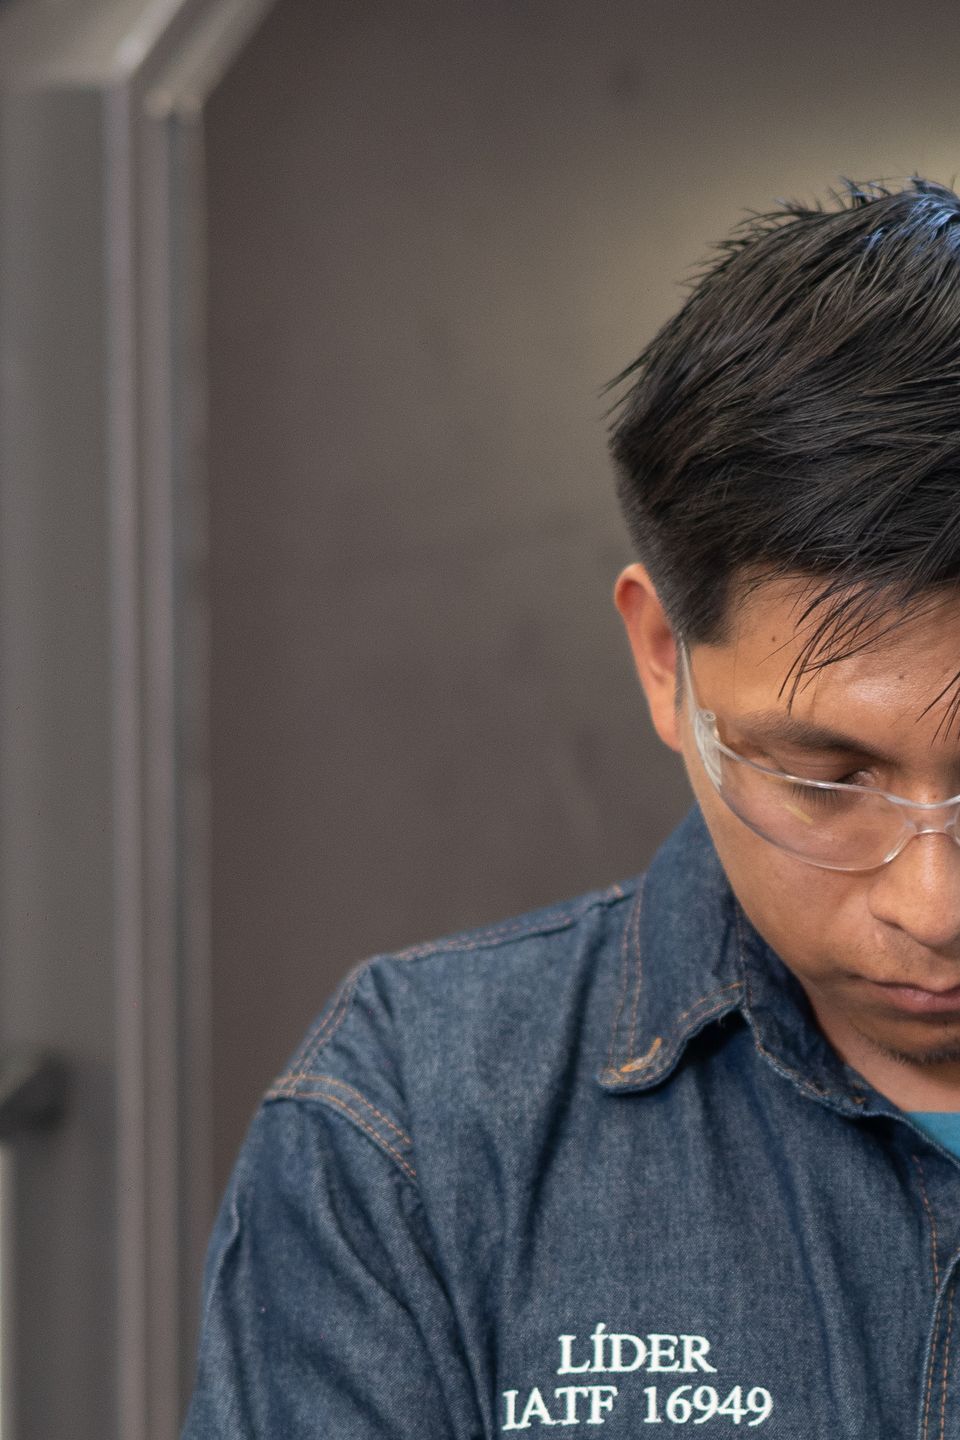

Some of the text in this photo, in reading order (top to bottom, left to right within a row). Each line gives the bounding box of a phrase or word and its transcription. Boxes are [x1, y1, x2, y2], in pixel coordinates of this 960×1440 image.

[557, 1322, 718, 1375] LÍDER
[502, 1385, 774, 1431] IATF 16949
